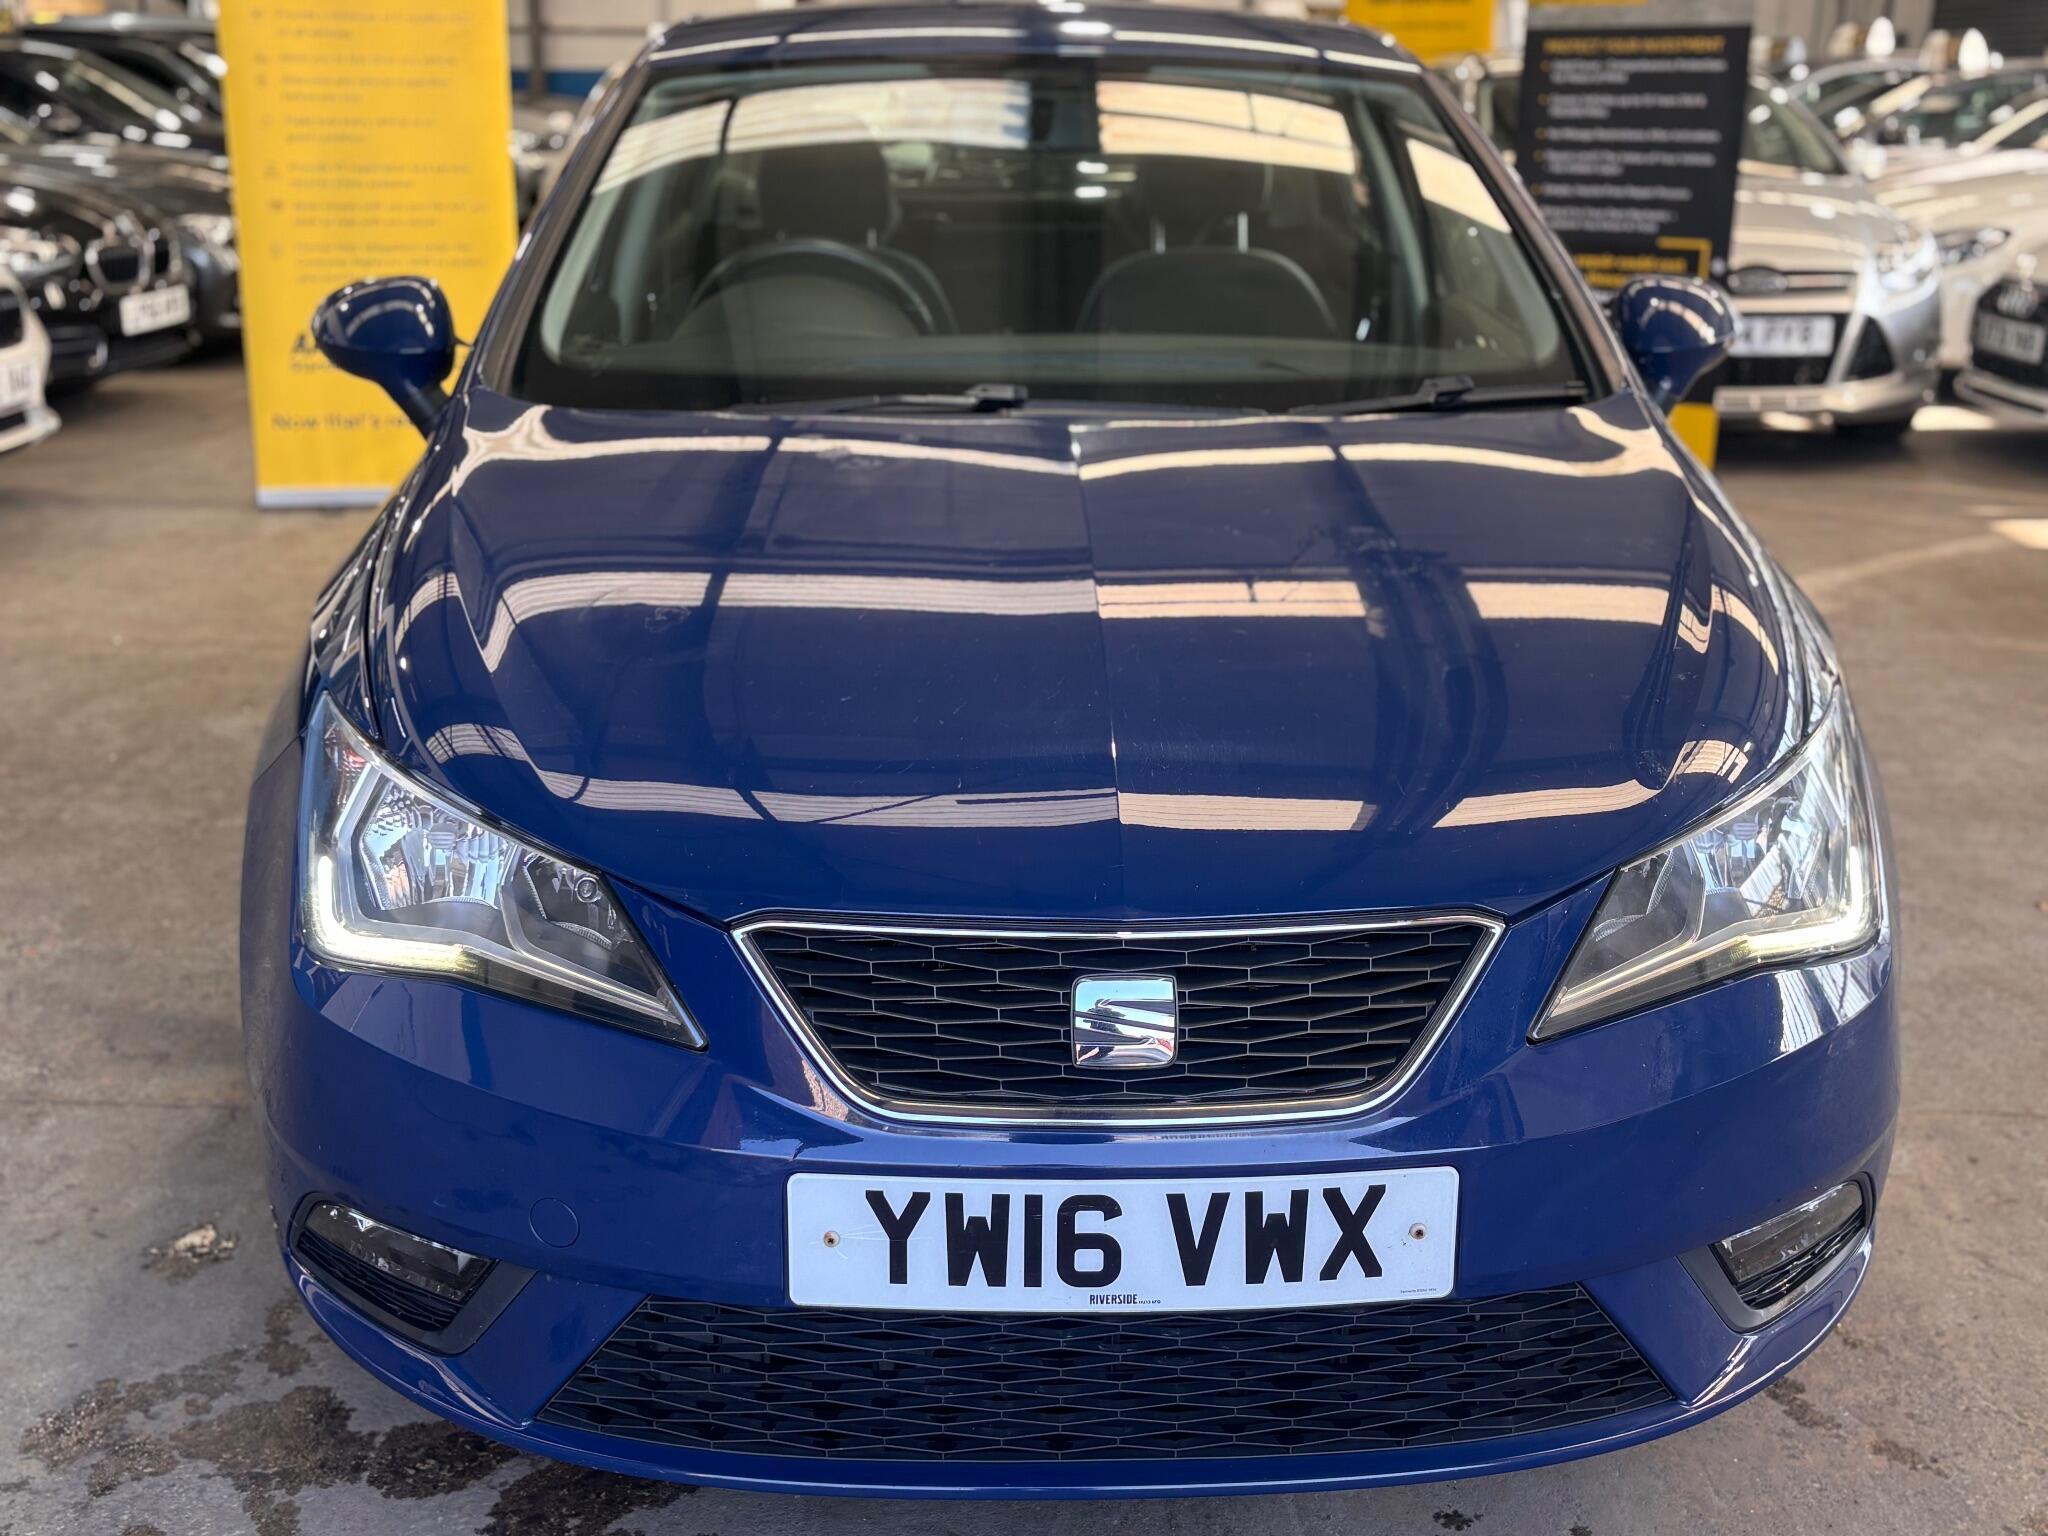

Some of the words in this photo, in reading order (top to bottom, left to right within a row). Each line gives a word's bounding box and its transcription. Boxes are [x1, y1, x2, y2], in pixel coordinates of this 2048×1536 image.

[866, 1189, 1122, 1288] YW16
[1166, 1184, 1386, 1287] VWX
[1089, 1294, 1138, 1305] RIVERSIDE
